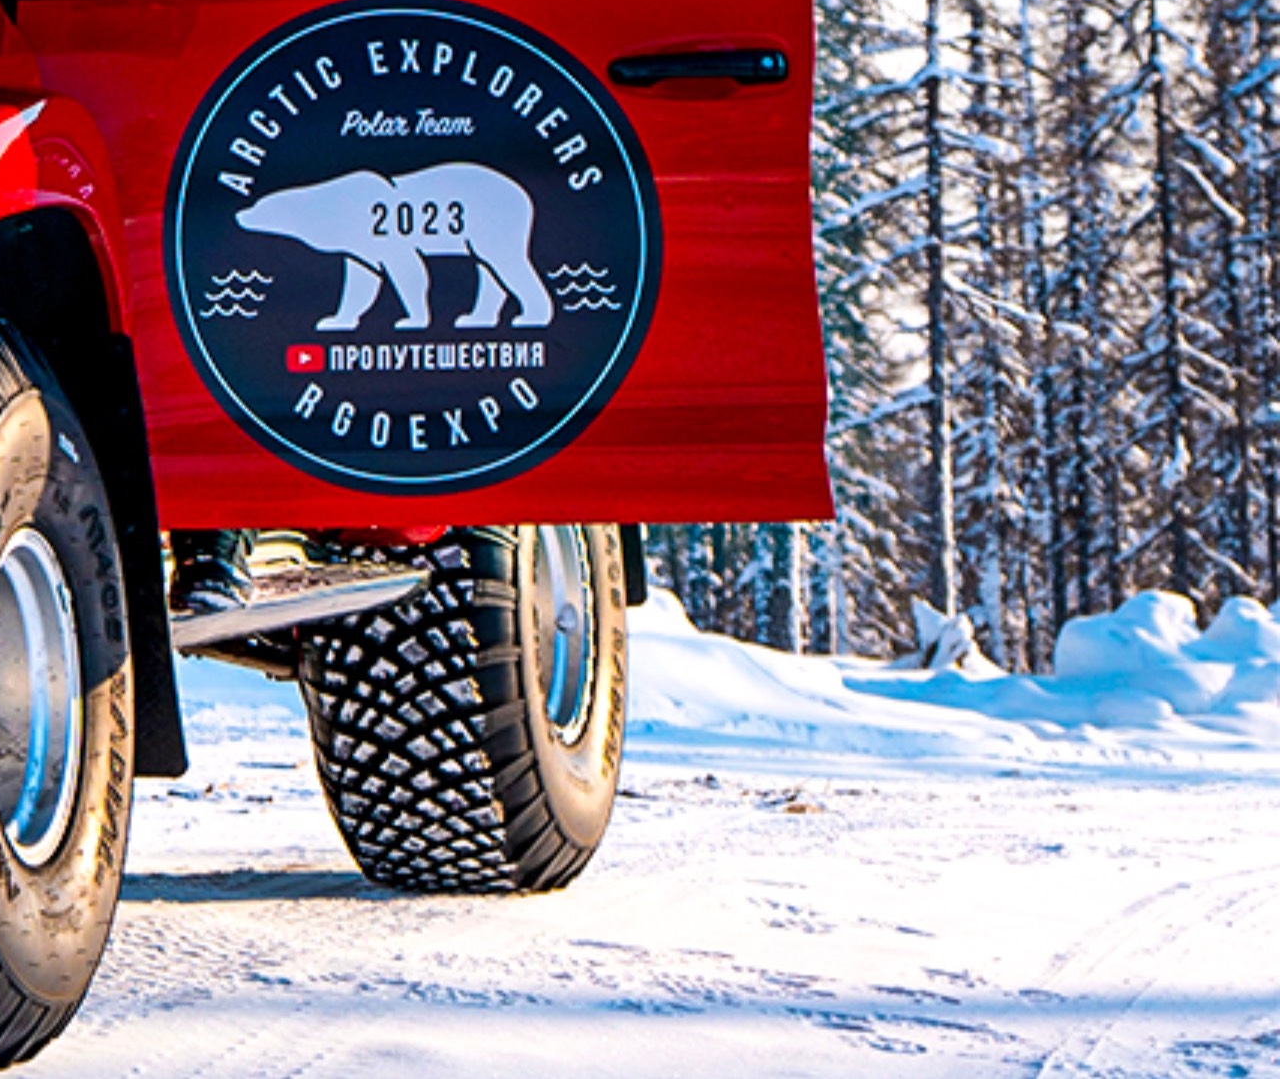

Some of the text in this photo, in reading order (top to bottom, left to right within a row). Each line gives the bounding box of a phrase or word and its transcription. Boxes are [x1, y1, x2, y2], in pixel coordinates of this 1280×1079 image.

[218, 38, 603, 196] ARCTIC EXPLORERS
[341, 108, 475, 137] Polar Team
[371, 201, 466, 236] 2023
[329, 342, 546, 371] ПРОПУТЕШЕСТВИЯ
[294, 377, 541, 450] RGOEXPO
